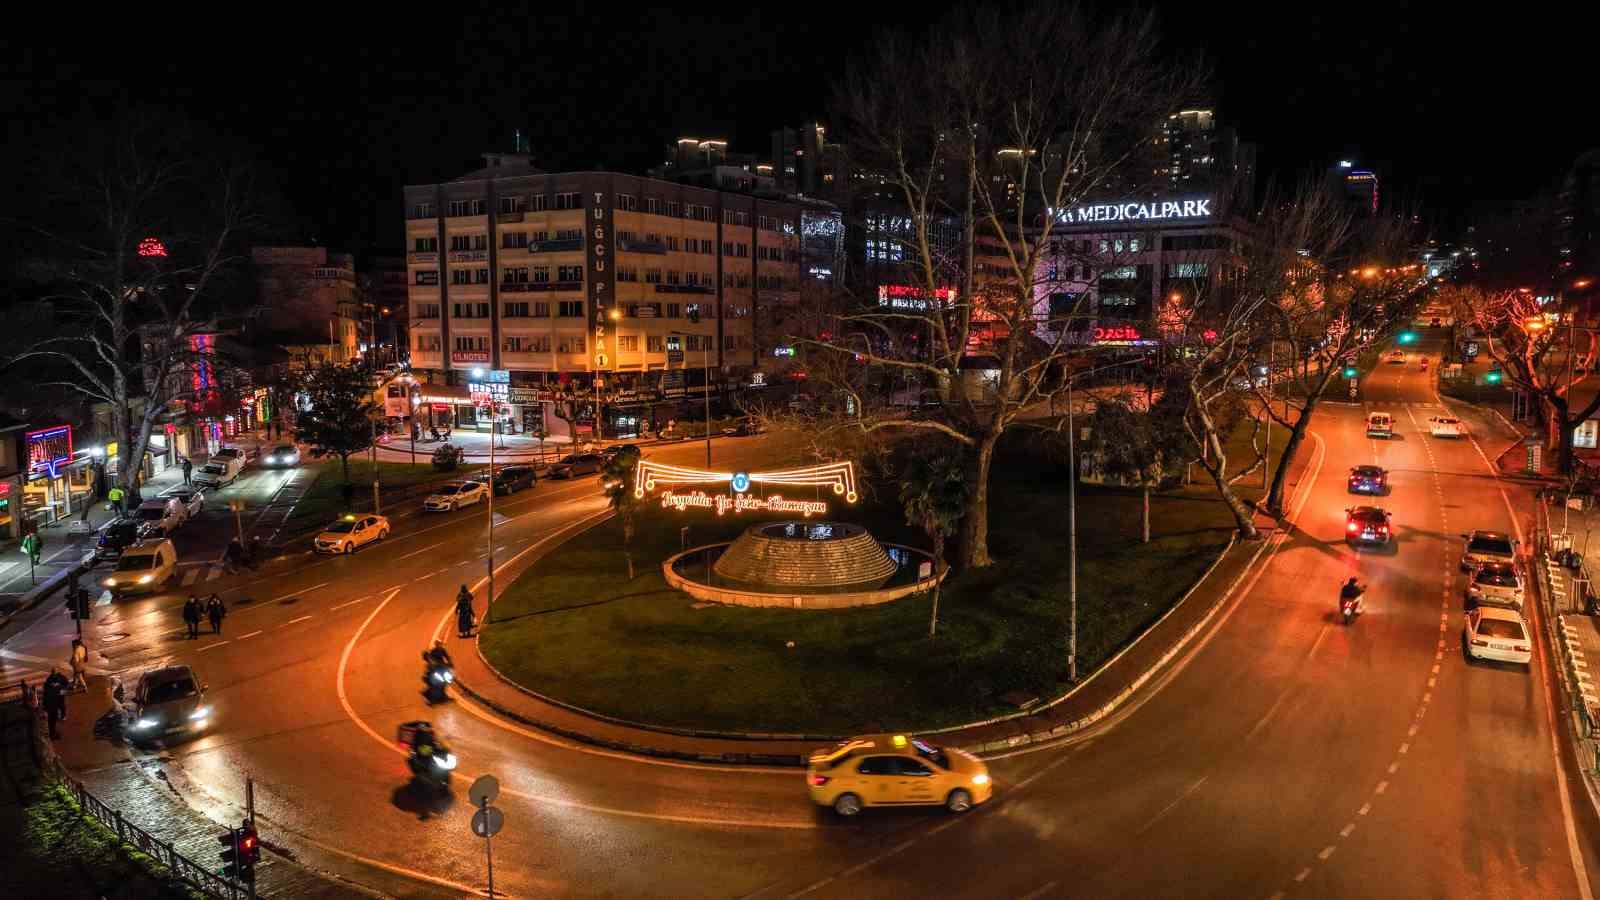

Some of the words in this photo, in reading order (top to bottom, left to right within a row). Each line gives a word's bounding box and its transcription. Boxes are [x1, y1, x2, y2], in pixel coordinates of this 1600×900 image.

[594, 192, 605, 272] TUĞCU
[1078, 199, 1211, 222] MEDICALPARK
[595, 283, 607, 350] PLAZA
